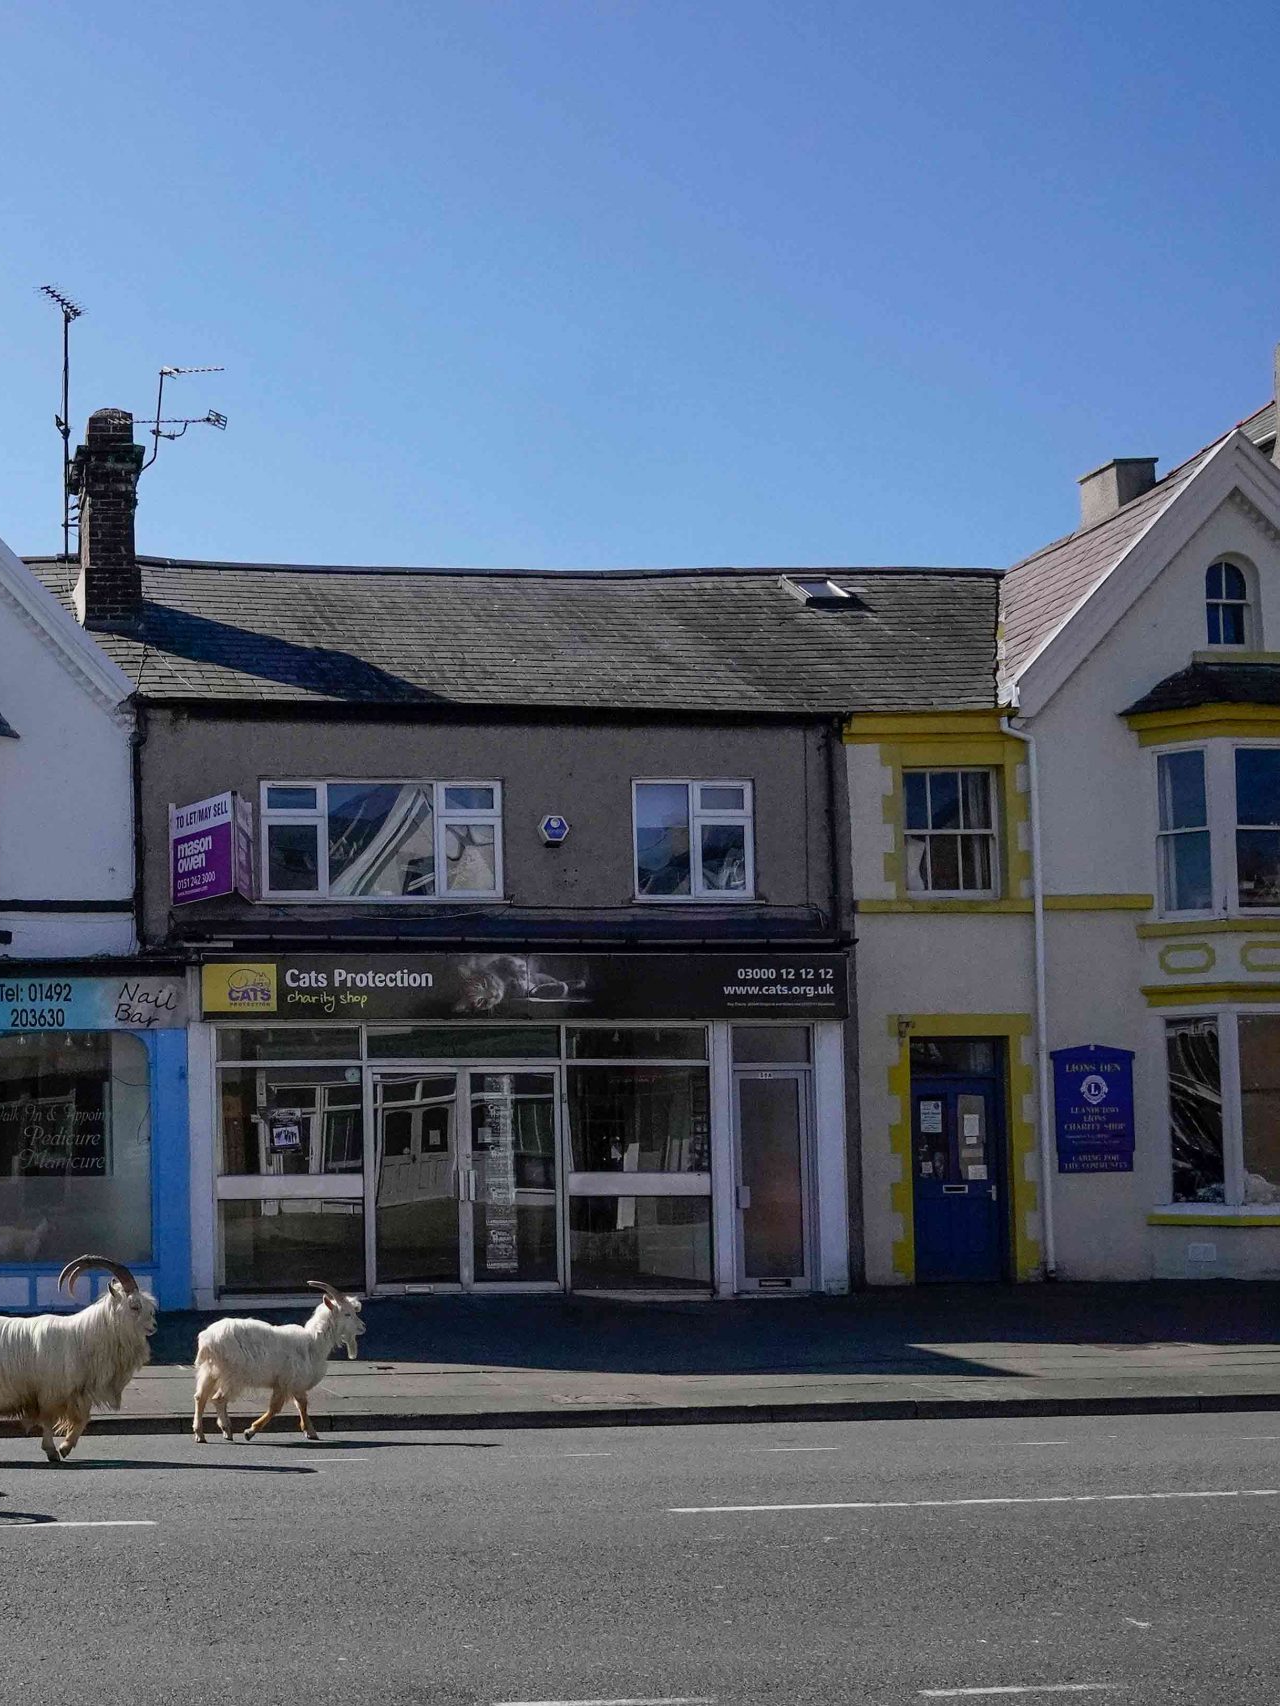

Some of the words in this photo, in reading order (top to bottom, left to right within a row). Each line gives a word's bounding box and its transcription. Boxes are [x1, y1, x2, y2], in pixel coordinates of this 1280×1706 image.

[176, 815, 184, 829] TO
[213, 800, 228, 817] SELL
[178, 835, 212, 859] mason
[178, 853, 206, 873] owen
[177, 878, 190, 890] 0151
[190, 874, 201, 887] 242
[202, 871, 216, 885] 3000
[285, 968, 328, 988] Cats
[333, 968, 433, 988] Protection
[737, 968, 777, 979] 03000
[780, 968, 796, 979] 12
[799, 968, 815, 979] 12
[818, 968, 834, 979] 12
[28, 983, 72, 1002] 01492
[119, 983, 177, 1010] Nail
[228, 988, 271, 1001] CATS
[723, 983, 835, 998] www.cats.org.uk
[287, 991, 336, 1013] charity
[340, 991, 368, 1009] shop
[10, 1008, 65, 1028] 203630
[115, 1003, 160, 1027] Bar
[1065, 1063, 1097, 1073] LIONS
[1100, 1063, 1121, 1073] DEN
